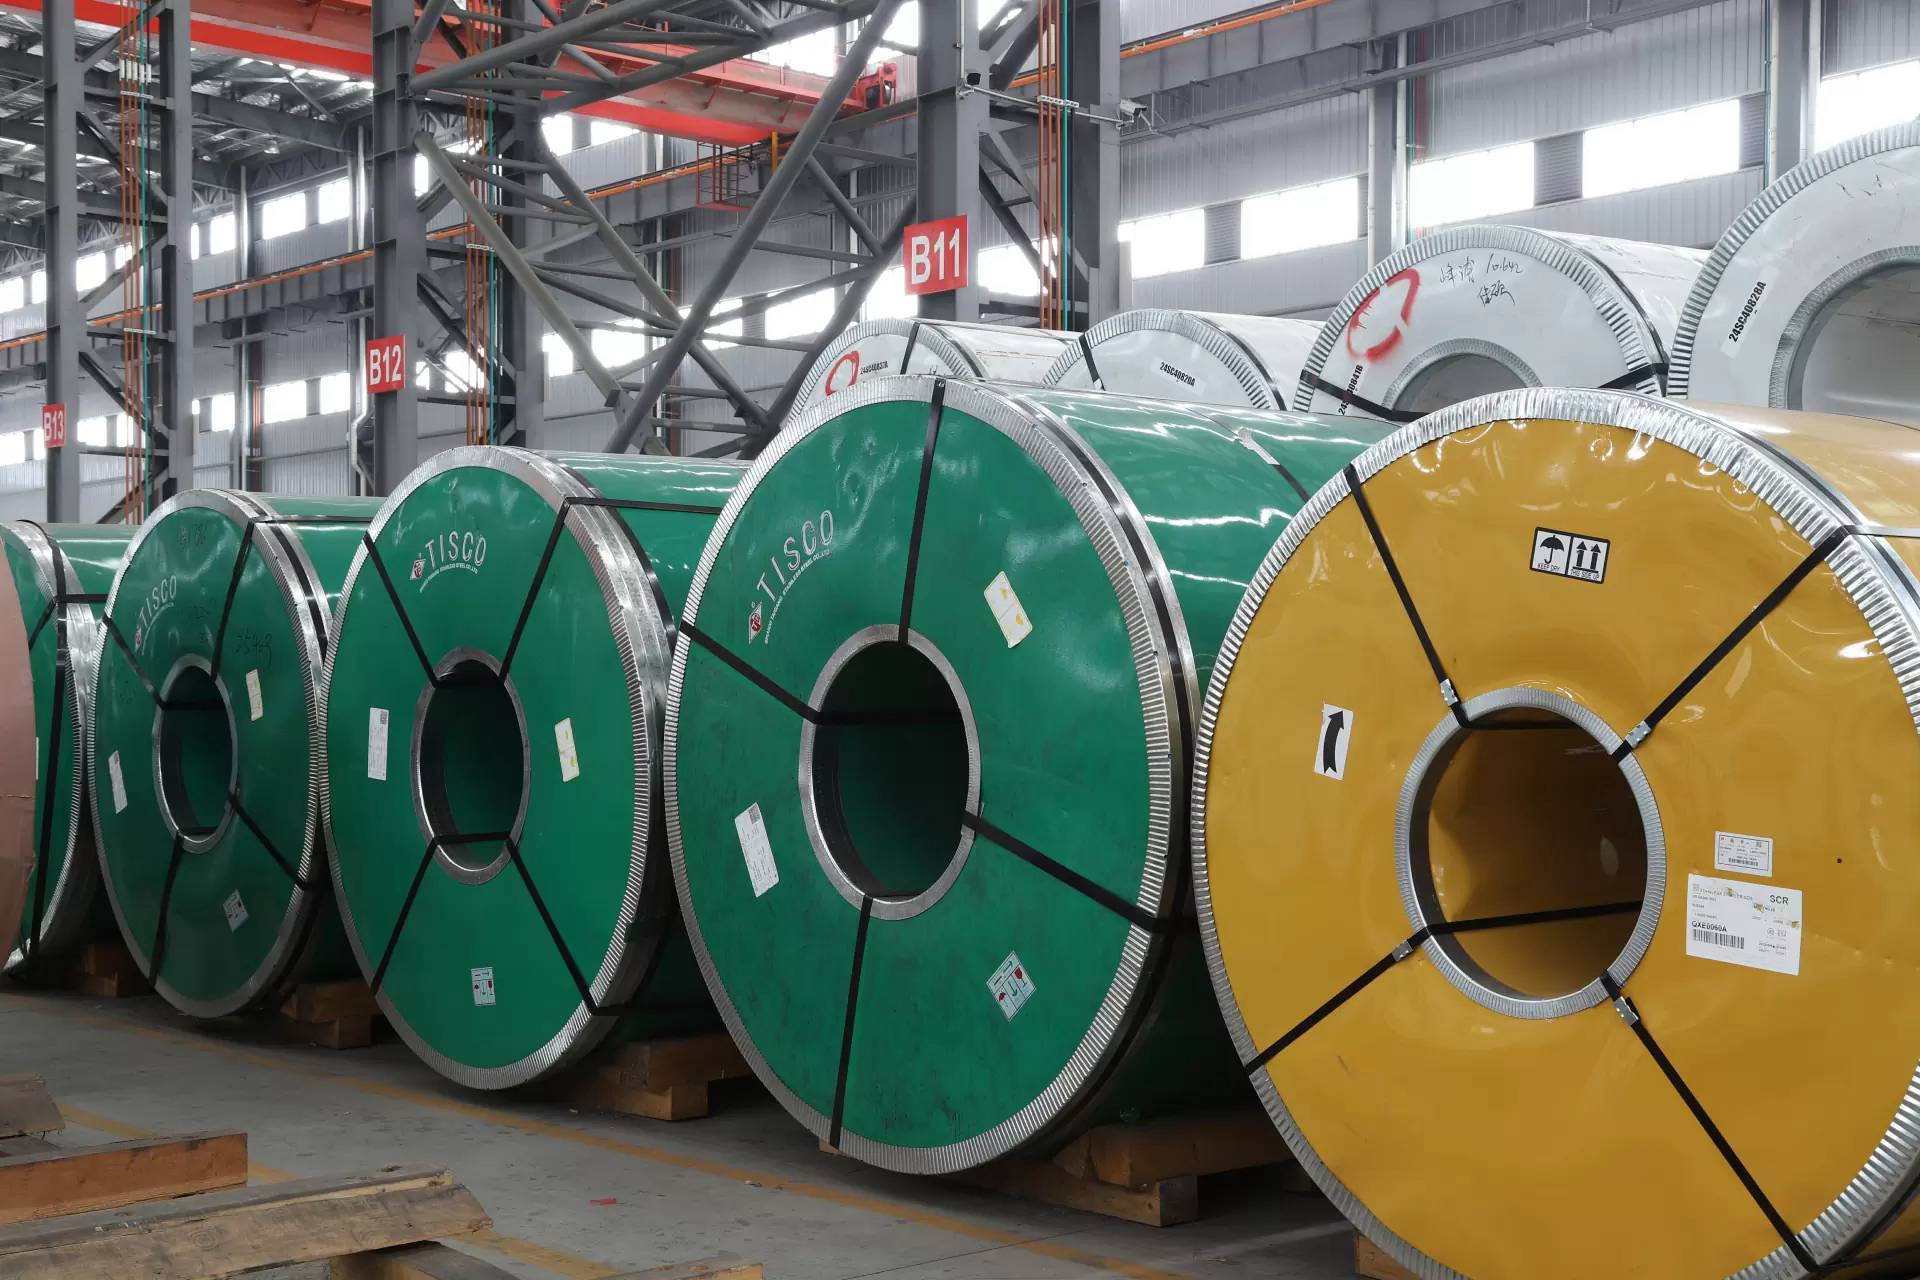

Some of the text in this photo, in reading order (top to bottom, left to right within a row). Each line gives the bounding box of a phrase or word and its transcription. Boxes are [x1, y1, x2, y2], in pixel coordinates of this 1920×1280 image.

[912, 228, 959, 284] B11
[1729, 281, 1766, 342] 24SC40828A
[370, 345, 401, 385] B12
[44, 411, 64, 440] B13
[425, 531, 486, 569] TISCO
[757, 510, 833, 601] TISCO
[139, 575, 177, 629] TISCO
[1769, 894, 1789, 906] SCR
